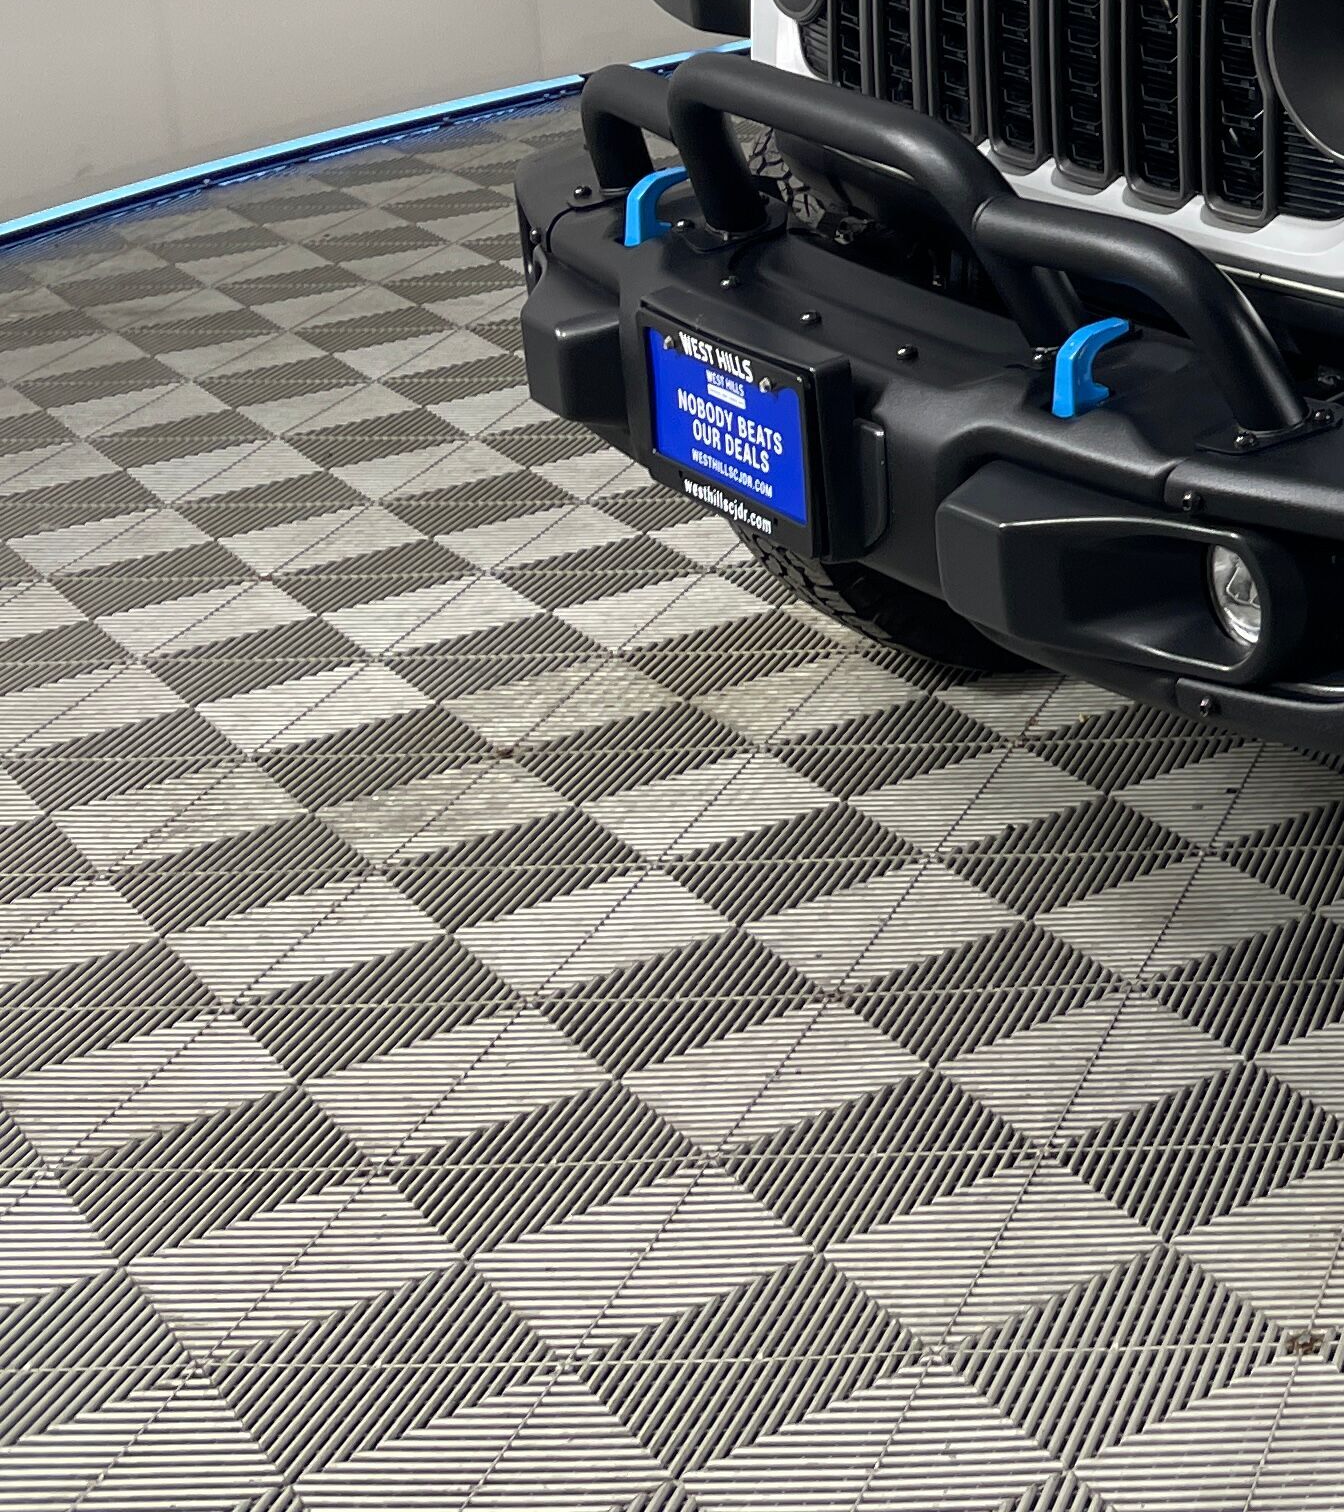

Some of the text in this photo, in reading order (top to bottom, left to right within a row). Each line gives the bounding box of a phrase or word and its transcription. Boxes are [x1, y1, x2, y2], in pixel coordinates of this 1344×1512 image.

[678, 331, 754, 384] WEST HILLS
[705, 369, 725, 388] WEST
[725, 377, 745, 397] HILLS
[677, 388, 733, 432] NOBODY
[737, 415, 783, 455] BEATS
[692, 418, 770, 473] OUR DEALS
[683, 478, 772, 535] westhillscjdr.com
